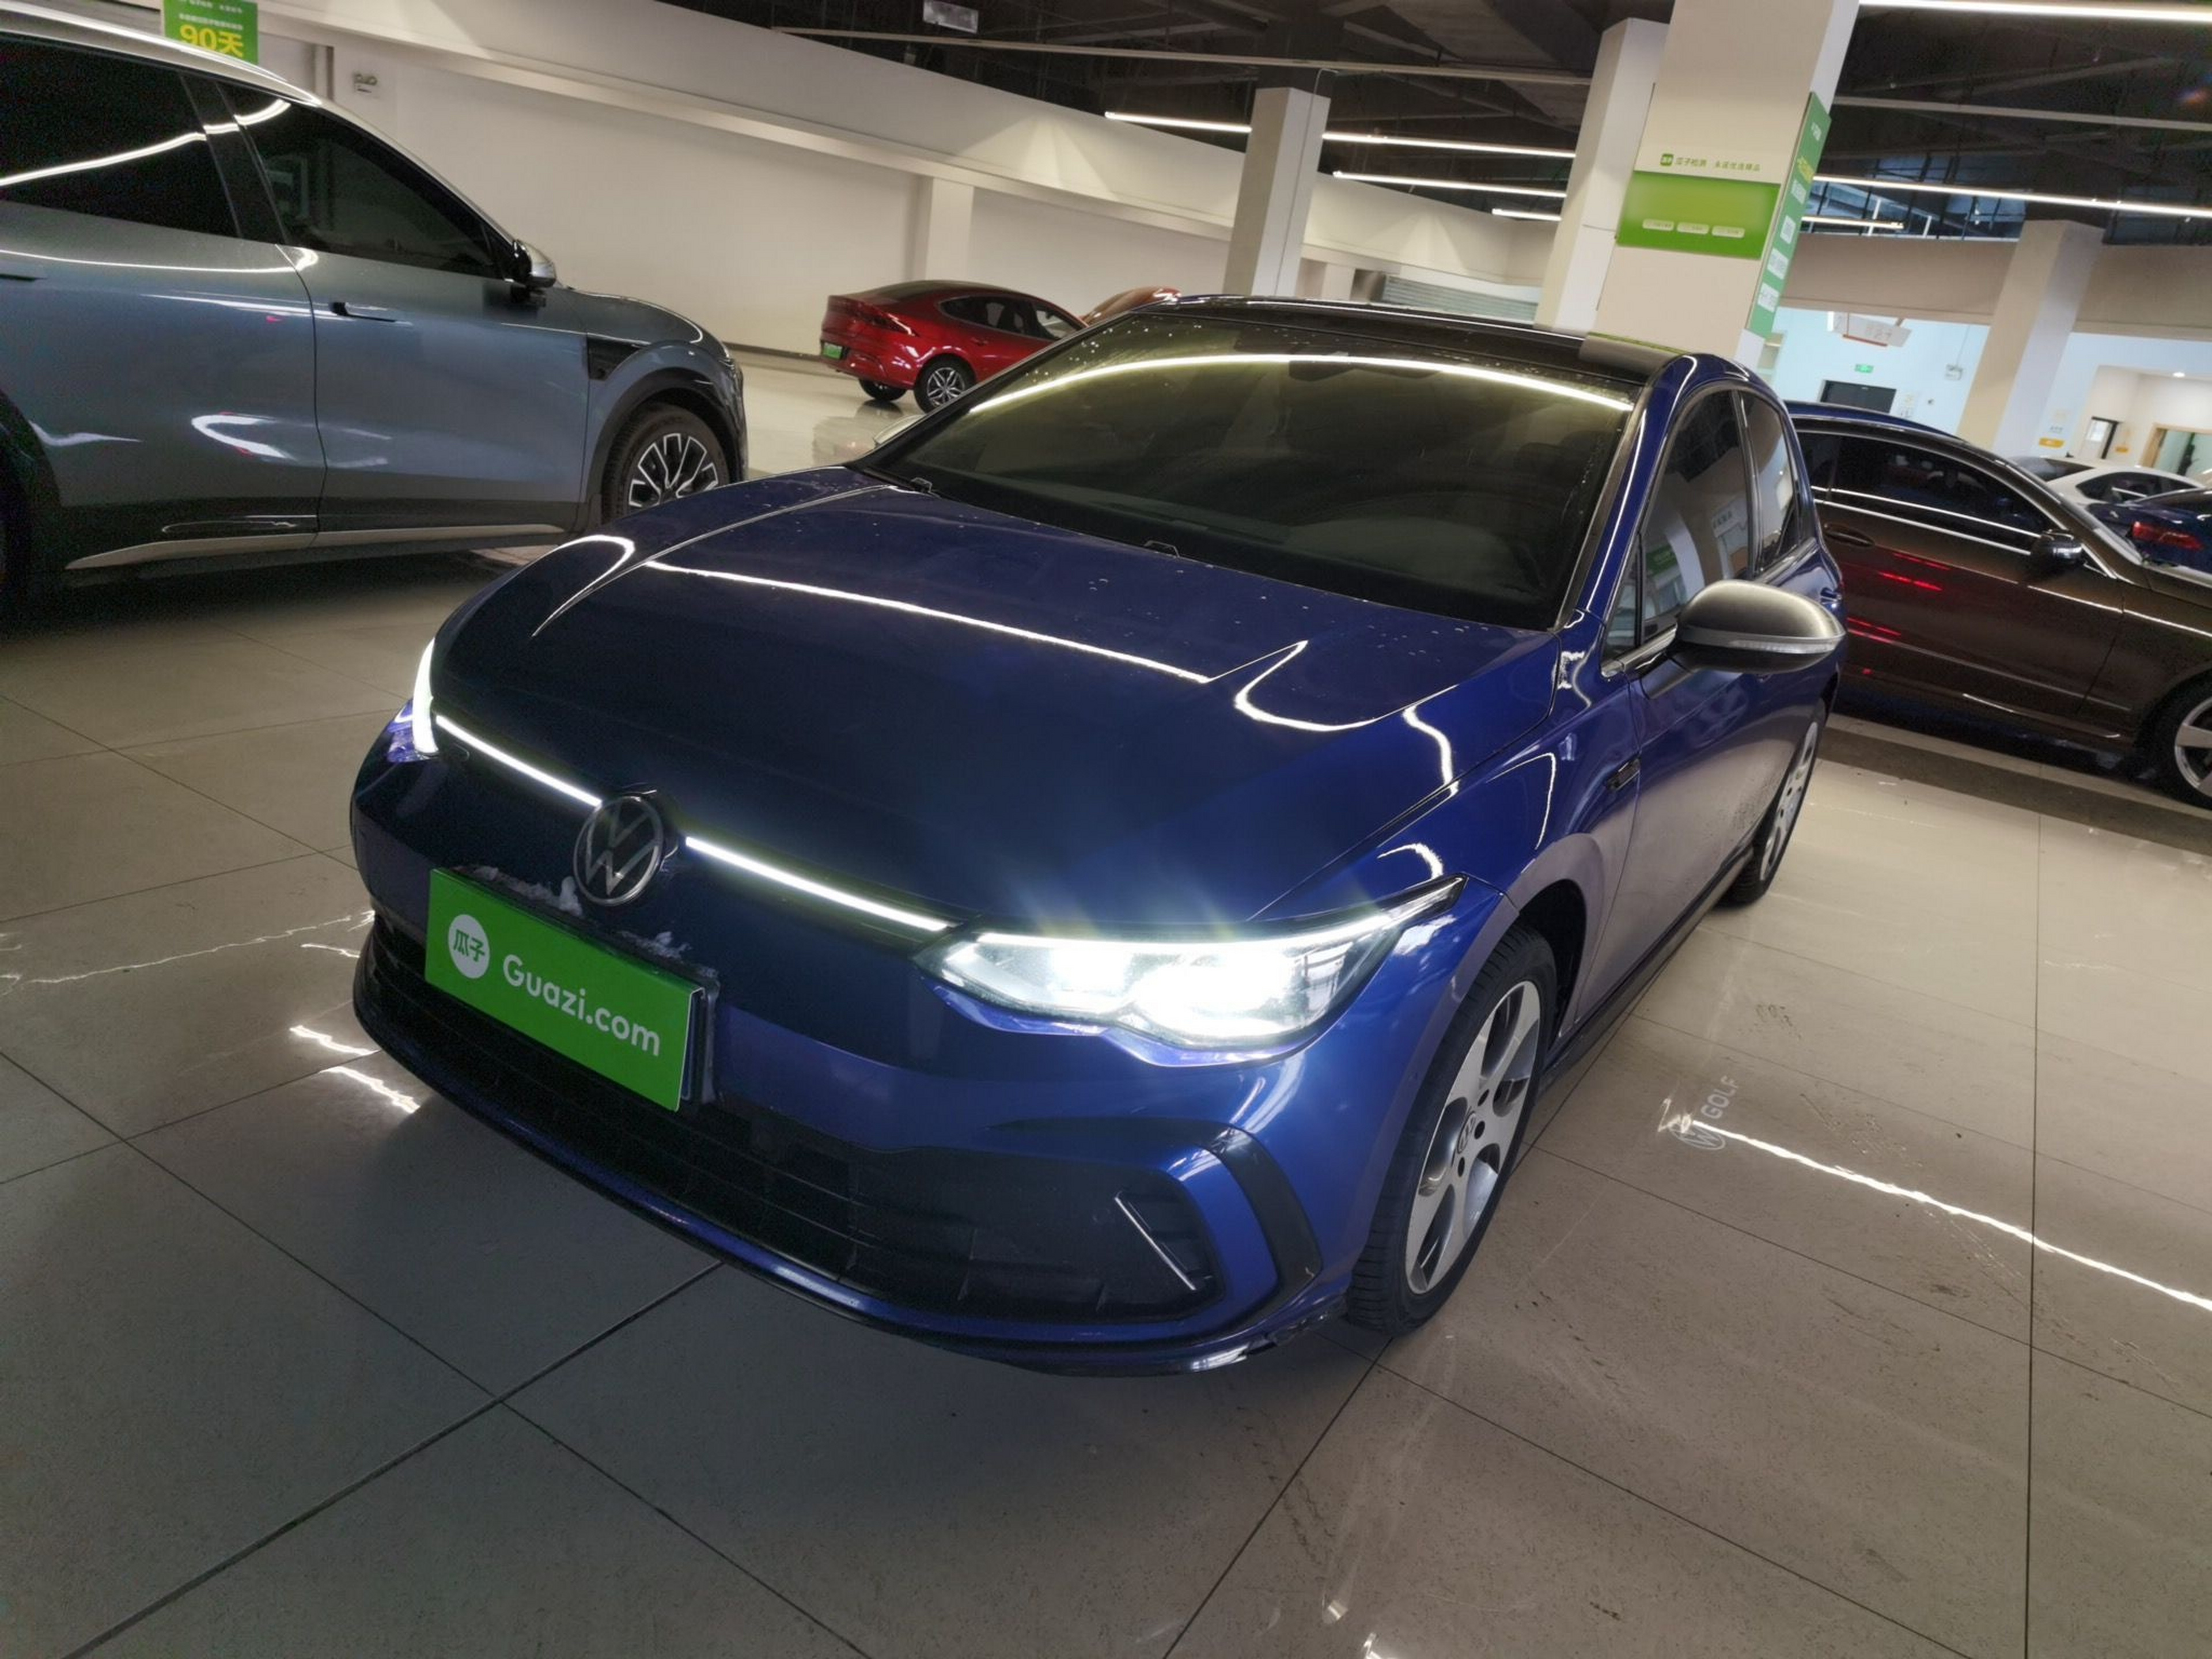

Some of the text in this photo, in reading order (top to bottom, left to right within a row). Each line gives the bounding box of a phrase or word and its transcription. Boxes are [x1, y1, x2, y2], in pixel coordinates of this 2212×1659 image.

[180, 25, 244, 58] 90天
[453, 929, 485, 962] 瓜子
[503, 954, 660, 1056] Guazi.com
[1700, 1075, 1738, 1119] GOLF
